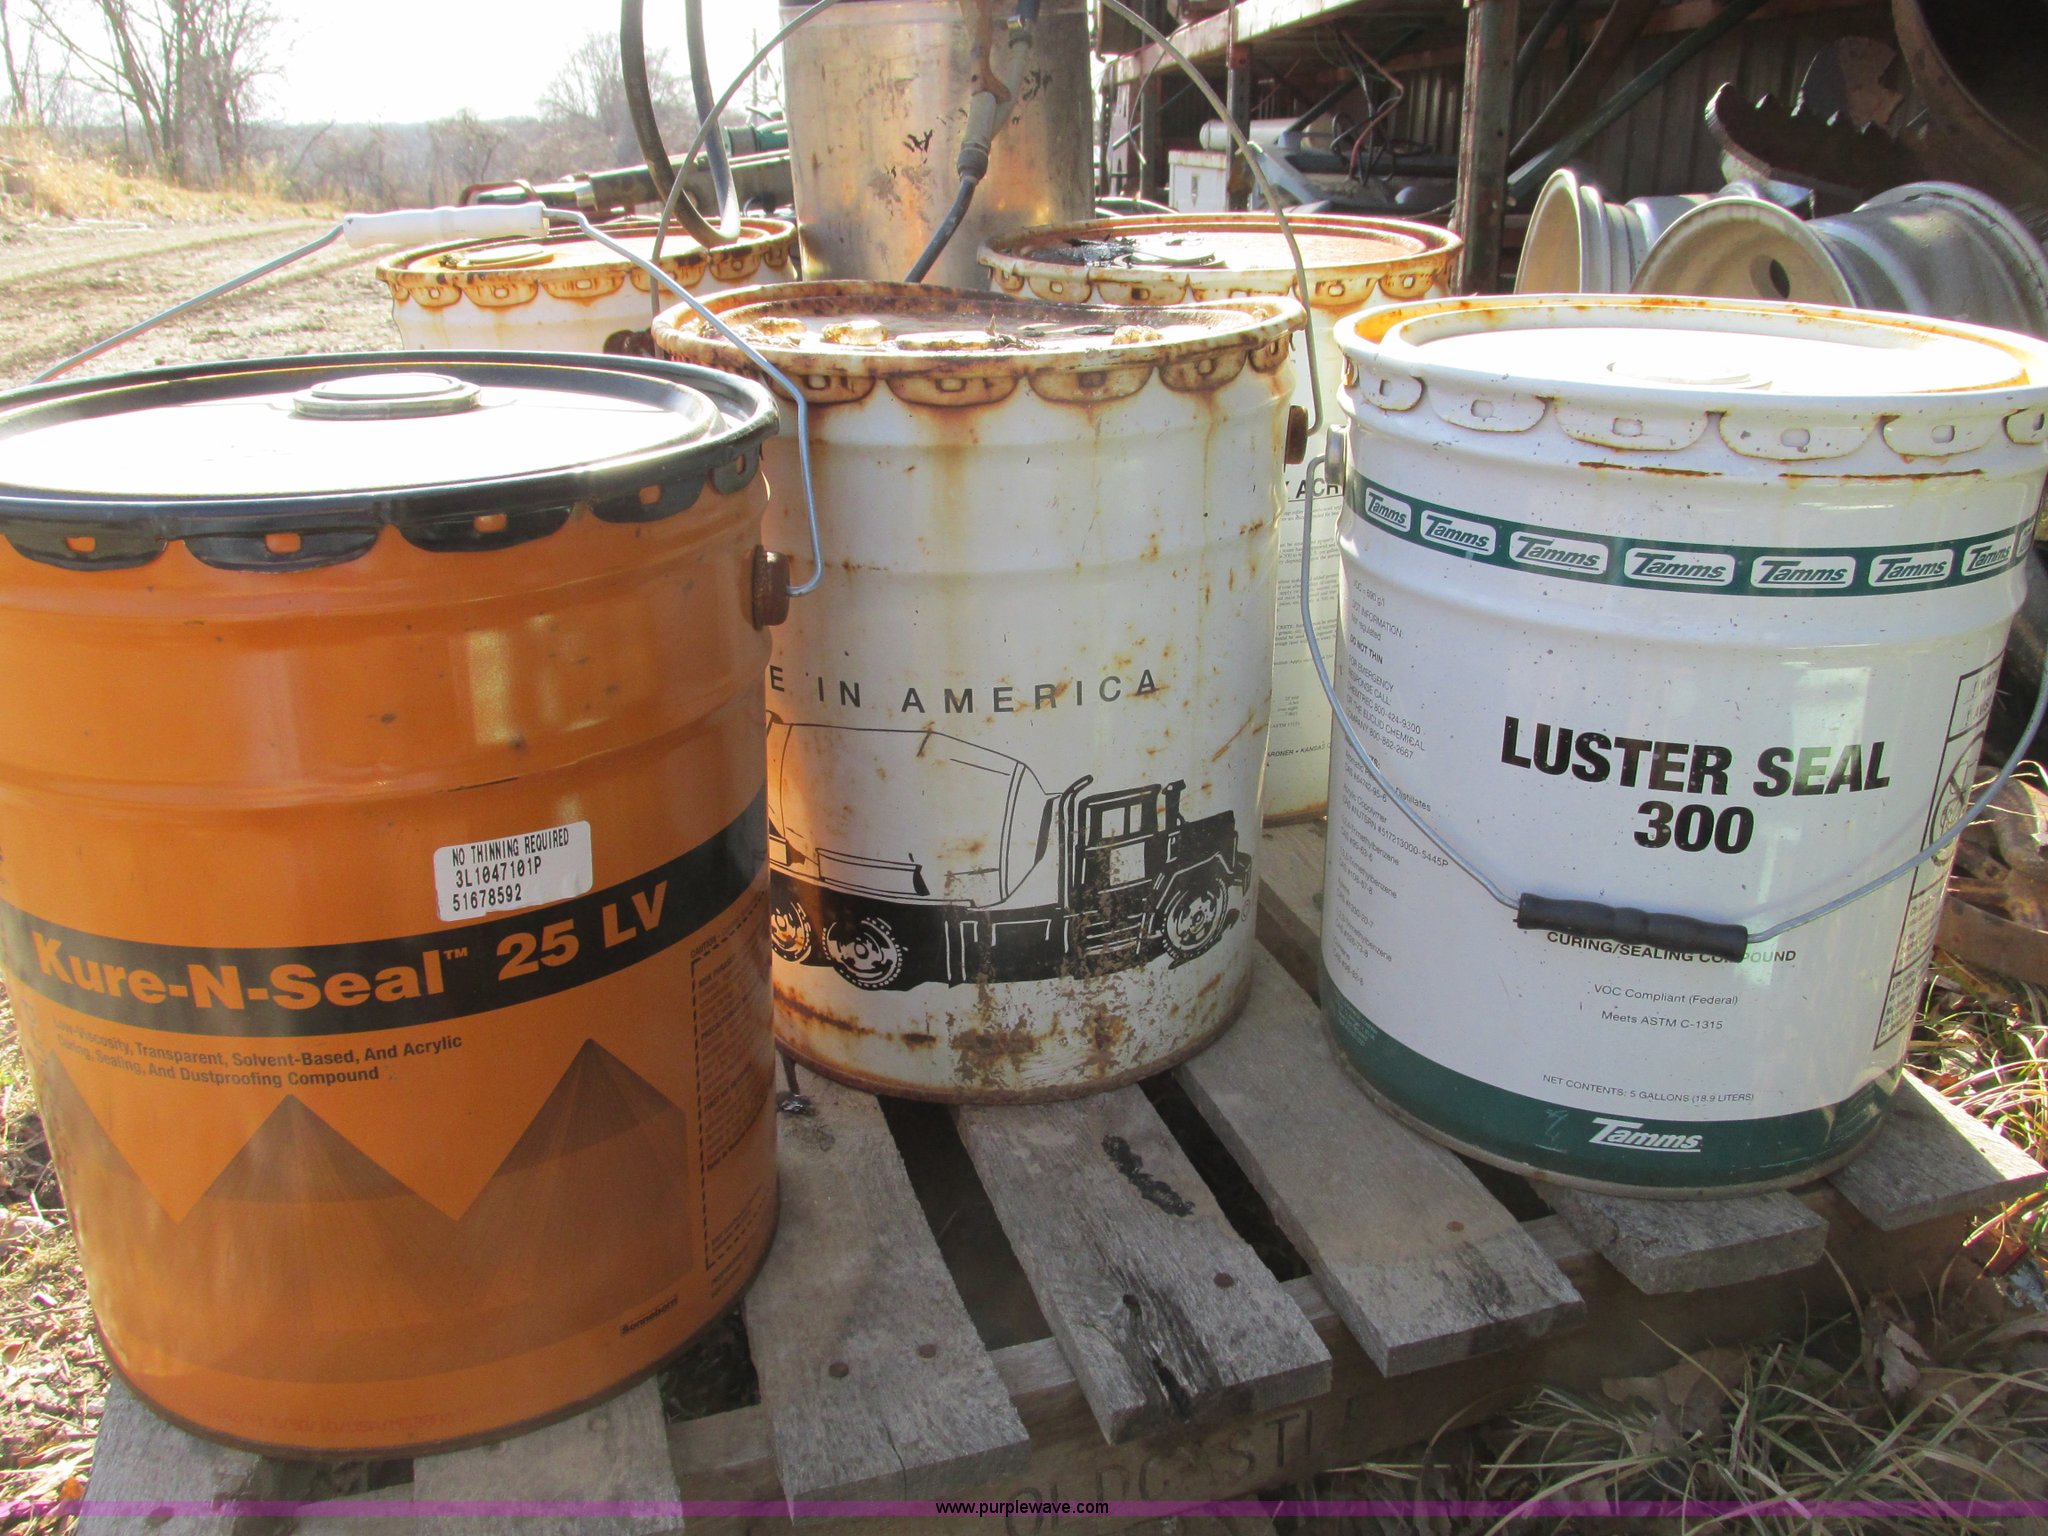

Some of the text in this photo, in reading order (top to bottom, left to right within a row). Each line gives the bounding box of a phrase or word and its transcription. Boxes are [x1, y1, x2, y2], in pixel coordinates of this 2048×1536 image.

[1368, 491, 1407, 528] Tamms
[1424, 514, 1490, 551] Tamms
[1516, 535, 1600, 571] Tamms
[1631, 552, 1727, 581] Tamms
[1874, 556, 1948, 582] Tamms
[1967, 544, 2011, 571] Tamms
[1757, 560, 1848, 584] Tamms
[1356, 640, 1368, 654] NOT
[1369, 648, 1383, 665] THIN
[817, 676, 861, 708] IN
[901, 669, 1158, 714] AMERICA
[1374, 705, 1421, 735] 800-424-9300
[1385, 724, 1425, 751] CHEMICAL
[1501, 715, 1891, 798] LUSTER SEAL
[1633, 800, 1755, 855] 300
[452, 827, 569, 867] NO THINNING REQUIRED
[456, 855, 542, 888] 3L1047101P
[453, 883, 522, 911] 51678592
[496, 918, 580, 981] 25
[602, 880, 668, 949] LV
[1547, 931, 1797, 963] CURING/SEALING COPOUND
[1594, 983, 1738, 1006] VOC Compliant (Federal)
[1601, 1010, 1723, 1030] Meets ASTM C-1315
[134, 1041, 229, 1068] Transparent,
[232, 1048, 360, 1067] Solvent-Based,
[364, 1045, 398, 1063] And
[403, 1034, 462, 1058] Acrylic
[95, 1050, 146, 1077] Sealing,
[149, 1063, 175, 1080] And
[181, 1066, 282, 1088] Dustproofing
[288, 1066, 379, 1087] Compound
[1542, 1074, 1564, 1085] NET
[1565, 1079, 1627, 1097] CONTENTS:
[1629, 1090, 1637, 1098] 5
[1638, 1090, 1690, 1102] GALLONS
[1717, 1093, 1755, 1102] LITERS)
[1589, 1117, 1703, 1152] Tamms
